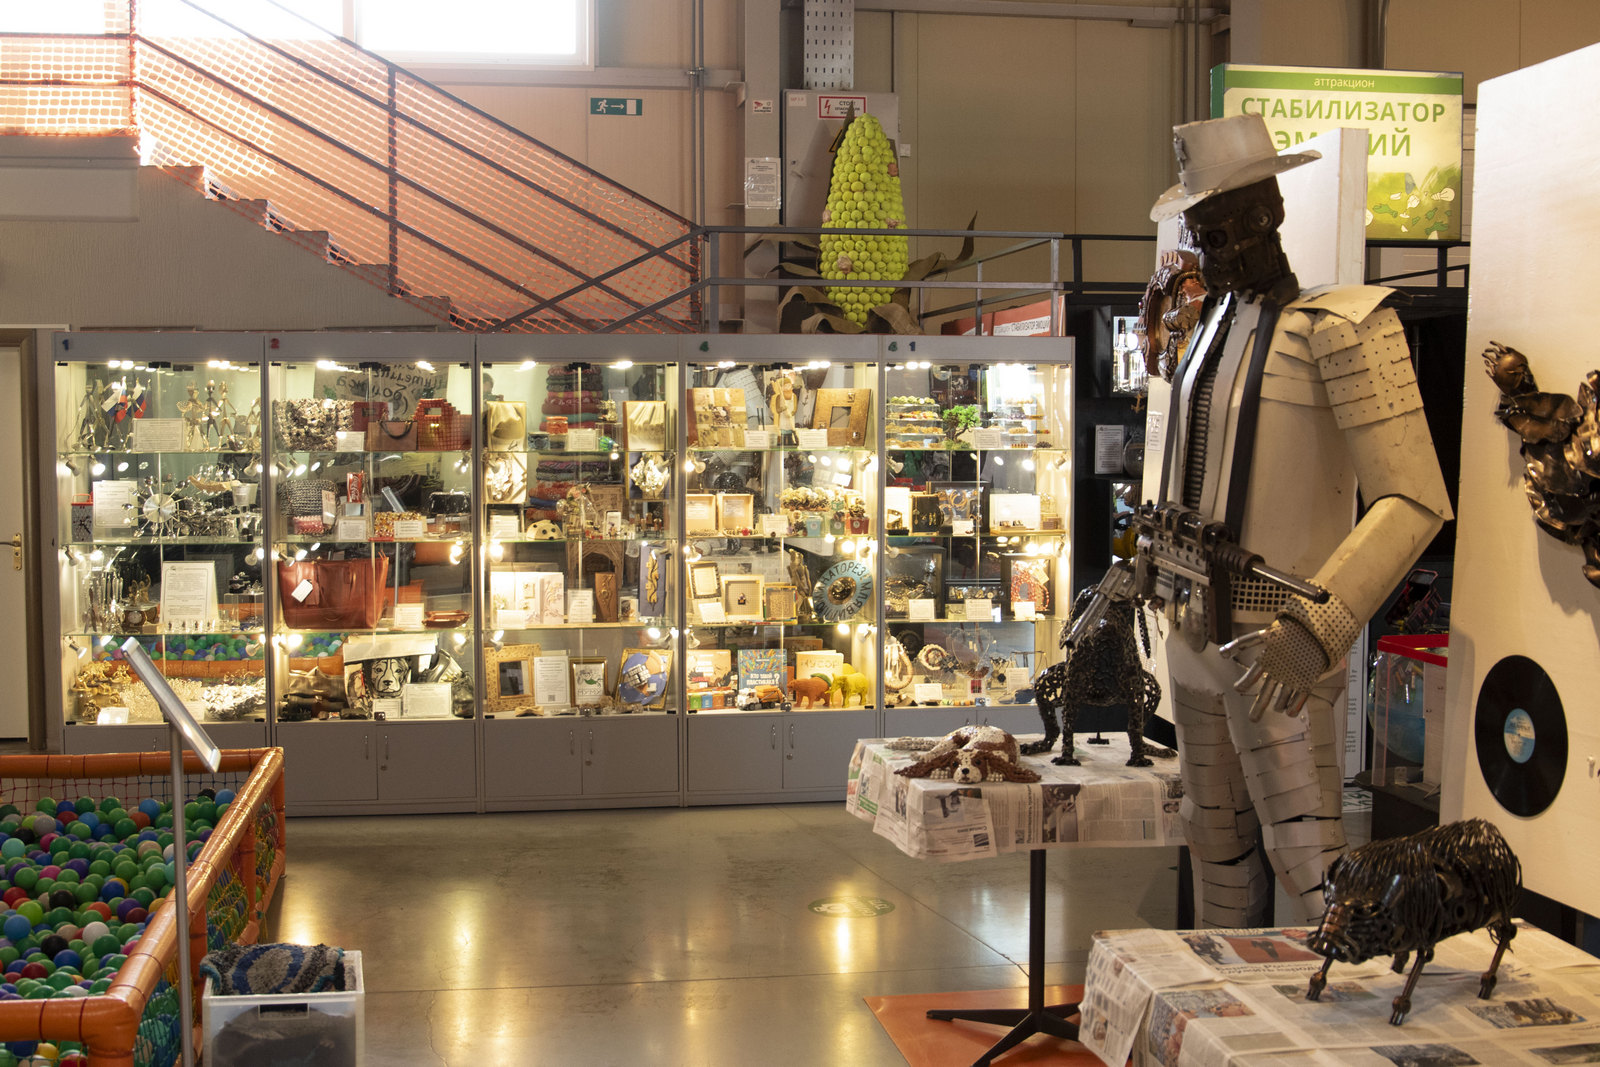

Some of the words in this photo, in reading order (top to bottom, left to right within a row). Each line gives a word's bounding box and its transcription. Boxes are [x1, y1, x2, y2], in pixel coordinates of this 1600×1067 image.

[1313, 77, 1375, 89] аттракцион
[1241, 97, 1446, 123] СТАБИЛИЗАТОР
[1275, 127, 1411, 157] ЭМИЙ
[62, 339, 69, 351] 1
[270, 338, 280, 349] 2
